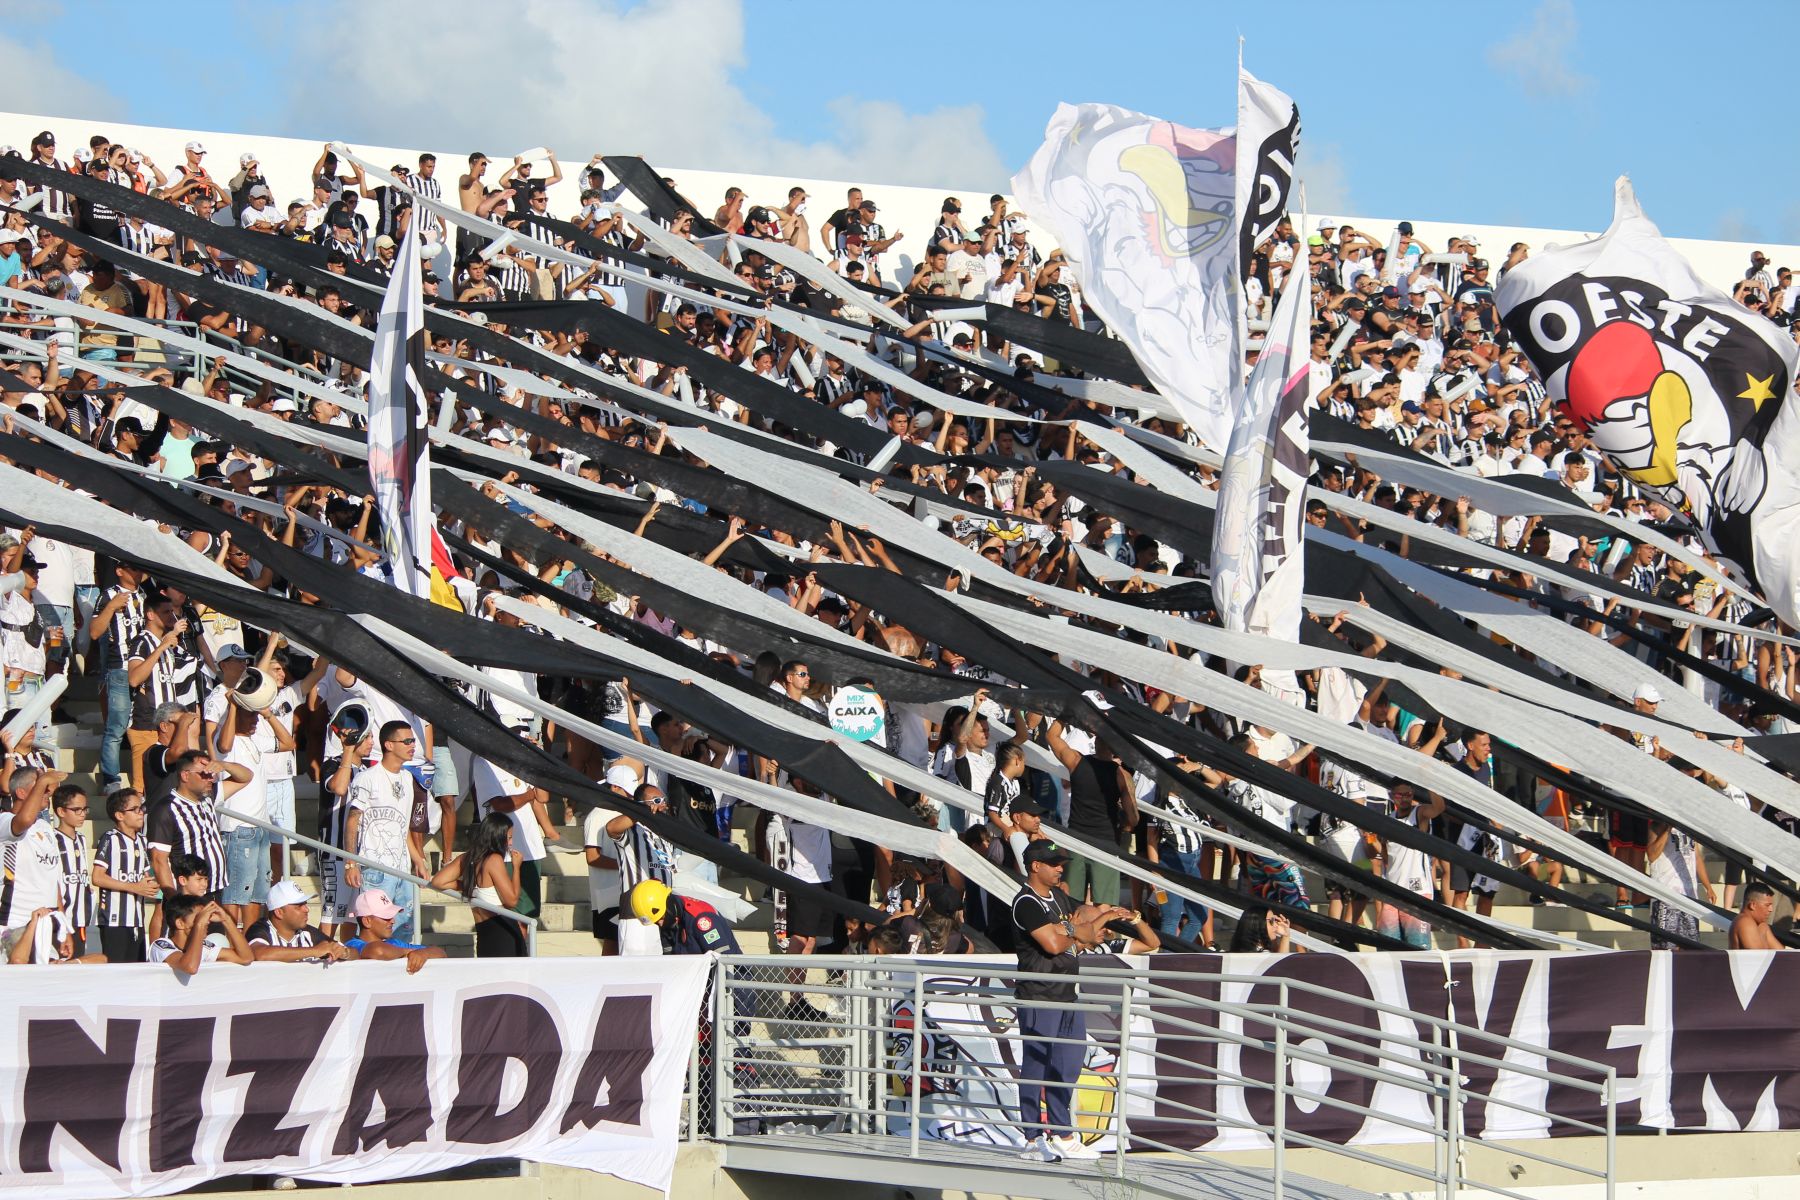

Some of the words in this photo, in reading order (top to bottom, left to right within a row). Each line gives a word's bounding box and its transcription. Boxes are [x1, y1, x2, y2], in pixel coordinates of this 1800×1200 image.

[1529, 282, 1731, 362] OESTE
[835, 706, 878, 716] CAIXA
[847, 694, 865, 702] MIX
[776, 841, 788, 921] JOEM
[0, 992, 655, 1175] NIZADA
[1126, 949, 1800, 1153] JOVEM
